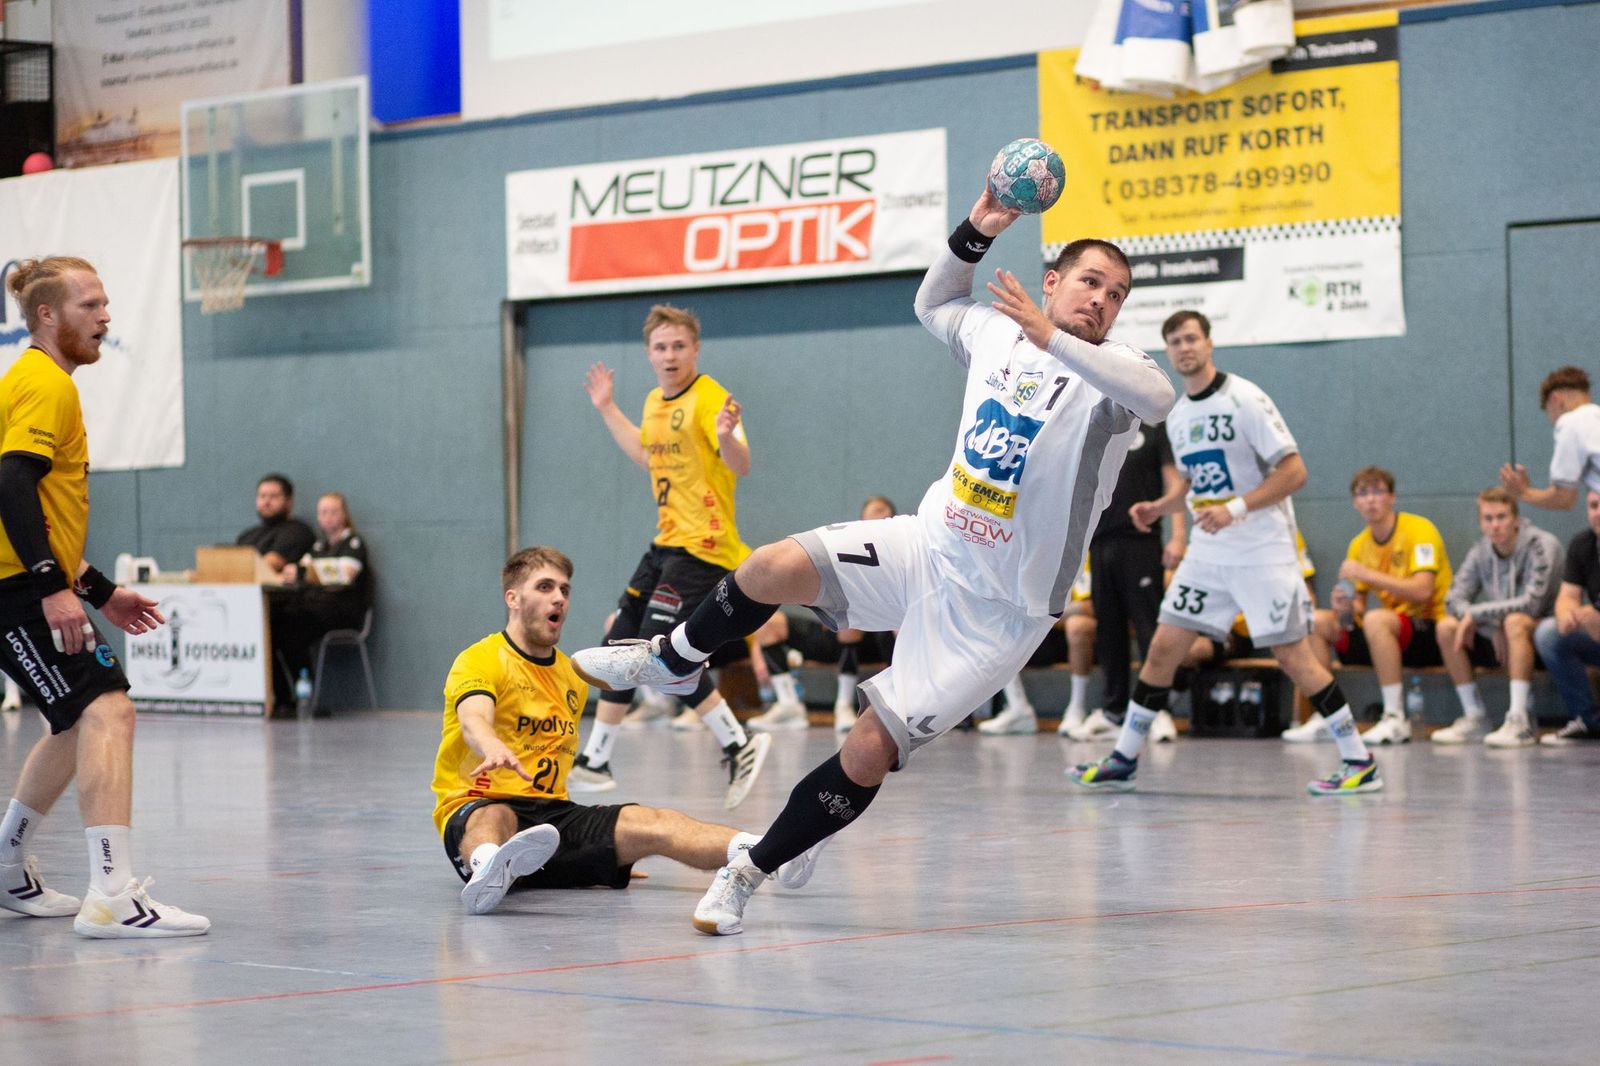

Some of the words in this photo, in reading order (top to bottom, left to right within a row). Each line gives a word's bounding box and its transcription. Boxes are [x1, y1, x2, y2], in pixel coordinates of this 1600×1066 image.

[1089, 99, 1233, 133] TRANSPORT
[1243, 87, 1346, 117] SOFORT,
[1109, 137, 1175, 165] DANN
[1183, 134, 1229, 159] RUF
[1240, 125, 1324, 150] KORTH
[570, 148, 877, 219] MEUTZNER
[684, 202, 874, 272] OPTIK
[1045, 375, 1070, 411] 7
[1207, 414, 1236, 442] 33
[837, 542, 880, 567] 7
[1173, 584, 1208, 614] 33
[185, 641, 256, 661] FOTOGRAF
[5, 631, 56, 705] tempton
[517, 714, 576, 737] Pyolys
[532, 757, 560, 794] 21
[16, 817, 29, 840] CRAFT
[101, 837, 112, 863] CRAFT
